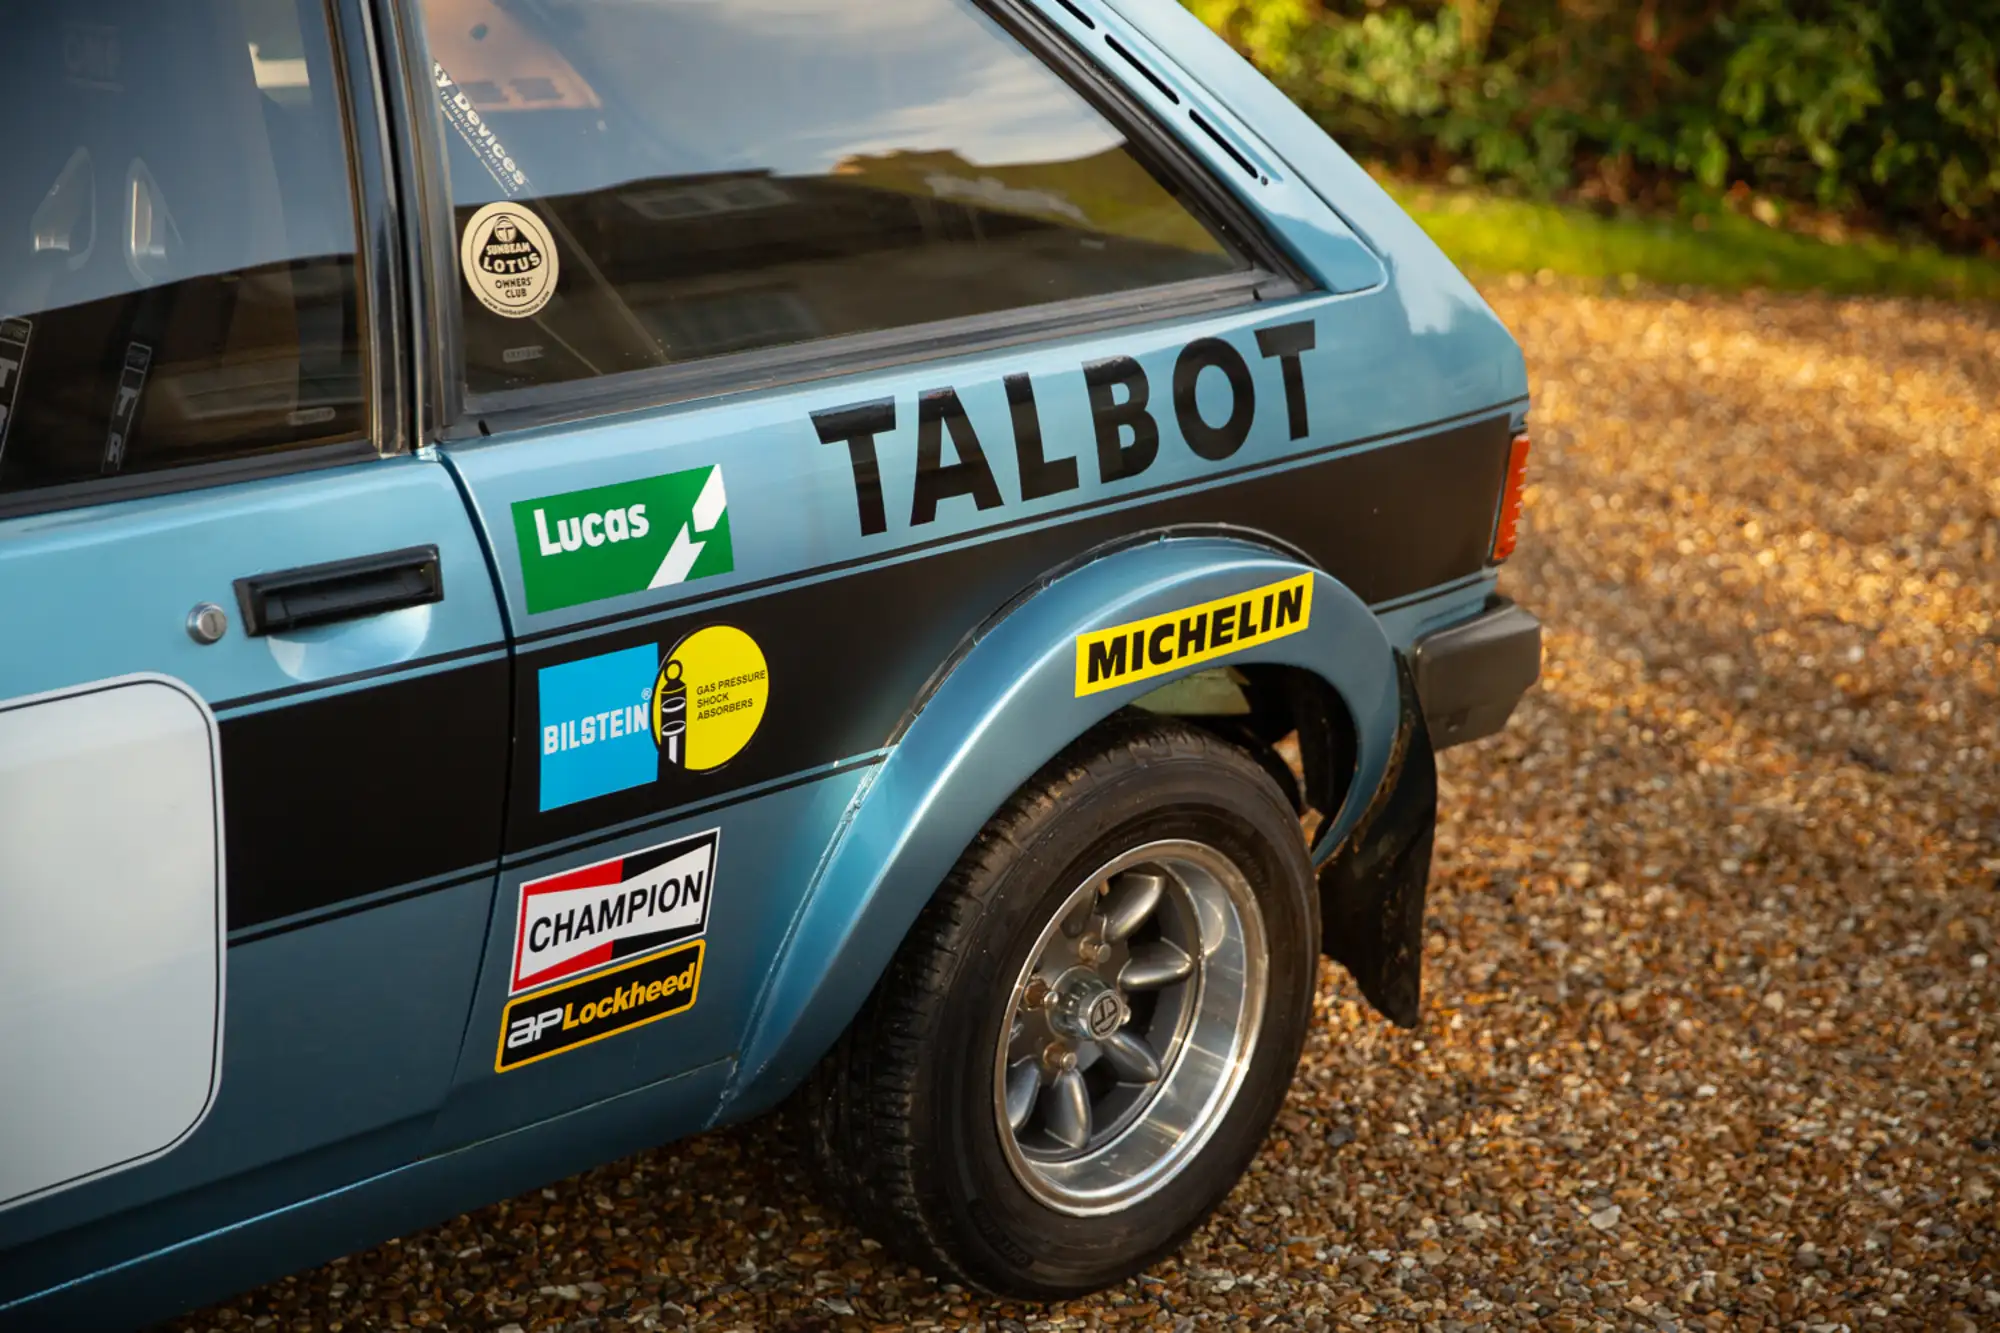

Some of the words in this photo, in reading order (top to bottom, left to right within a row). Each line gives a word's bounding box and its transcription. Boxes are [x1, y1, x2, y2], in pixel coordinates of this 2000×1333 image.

[441, 91, 477, 137] TECHNOLOGY
[485, 149, 519, 192] PROTECTION
[454, 91, 525, 185] Devices
[484, 253, 540, 273] LOTUS
[486, 242, 531, 255] SUNBEAM
[505, 288, 527, 298] CLUB
[809, 320, 1315, 536] TALBOT
[533, 504, 649, 556] Lucas
[1087, 585, 1304, 684] MICHELIN
[696, 682, 716, 695] GAS
[718, 670, 766, 690] PRESSURE
[697, 692, 729, 708] SHOCK
[544, 703, 648, 755] BILSTEIN
[697, 698, 753, 720] ABSORBERS
[529, 870, 704, 953] CHAMPION
[562, 962, 695, 1031] Lockheed
